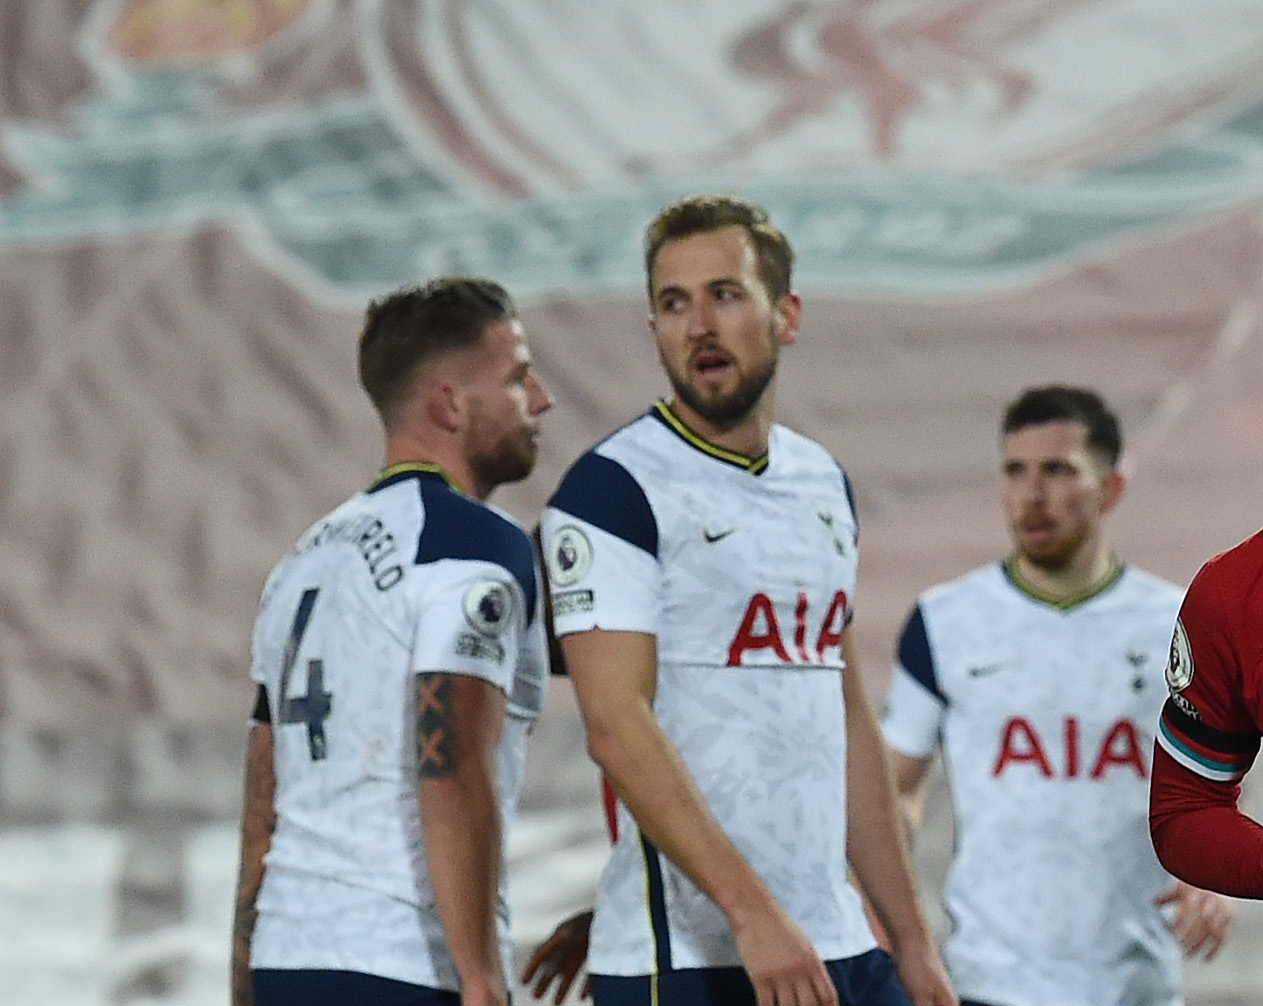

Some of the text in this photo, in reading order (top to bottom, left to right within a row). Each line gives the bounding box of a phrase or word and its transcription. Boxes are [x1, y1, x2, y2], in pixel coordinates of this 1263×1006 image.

[726, 589, 847, 667] AIA
[279, 587, 333, 761] 4
[992, 716, 1147, 779] AIA
